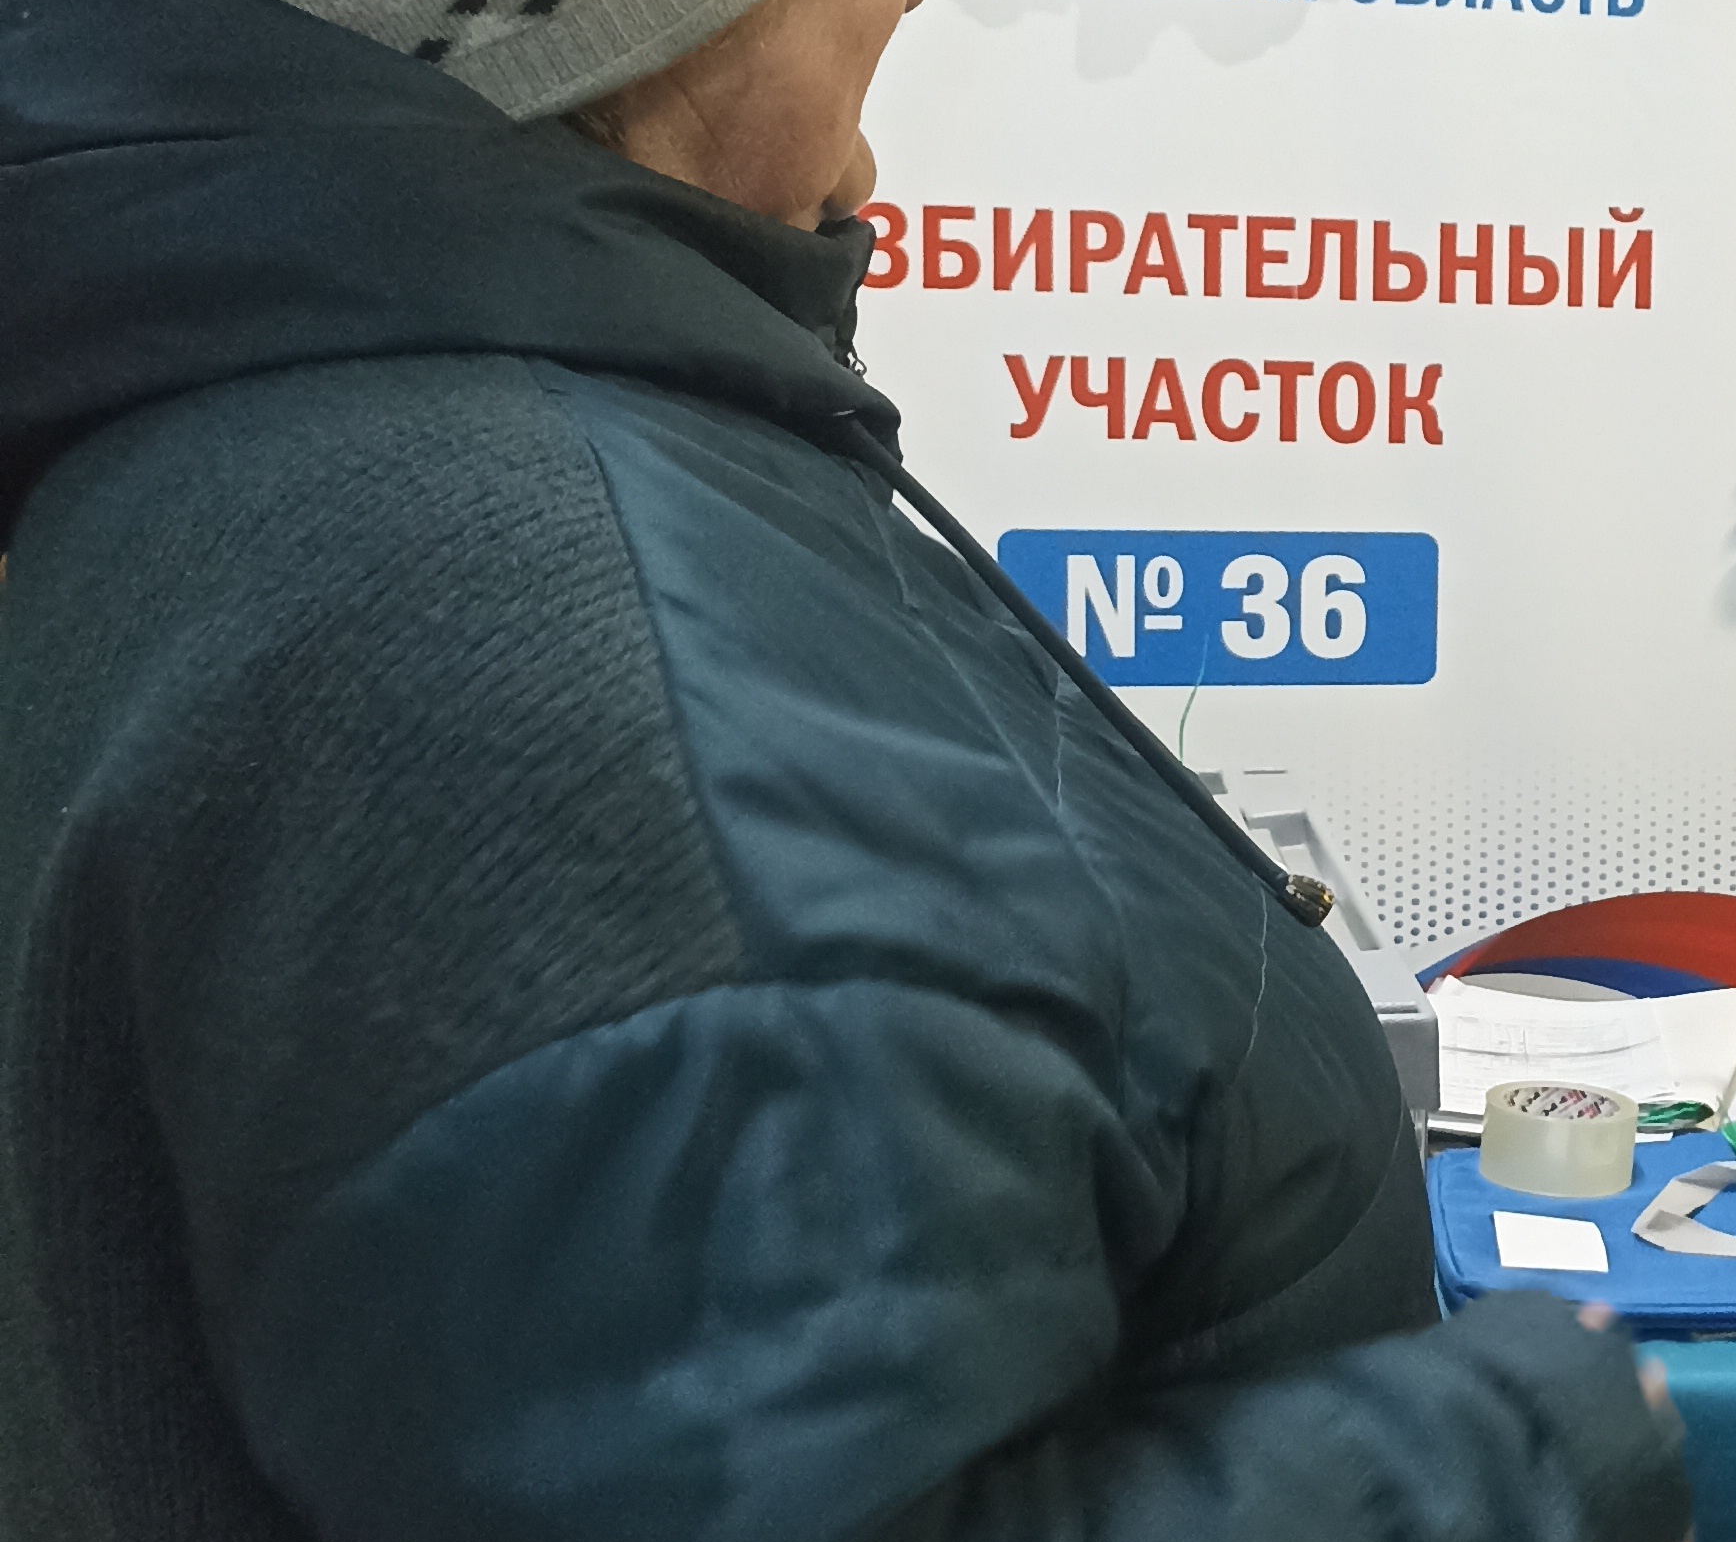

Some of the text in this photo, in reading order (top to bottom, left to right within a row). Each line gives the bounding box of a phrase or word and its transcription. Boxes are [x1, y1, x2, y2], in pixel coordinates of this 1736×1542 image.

[856, 201, 1655, 311] ЗБИРАТЕЛЬНЫЙ
[1002, 353, 1444, 446] УЧАСТОК
[1065, 552, 1368, 660] № 36
